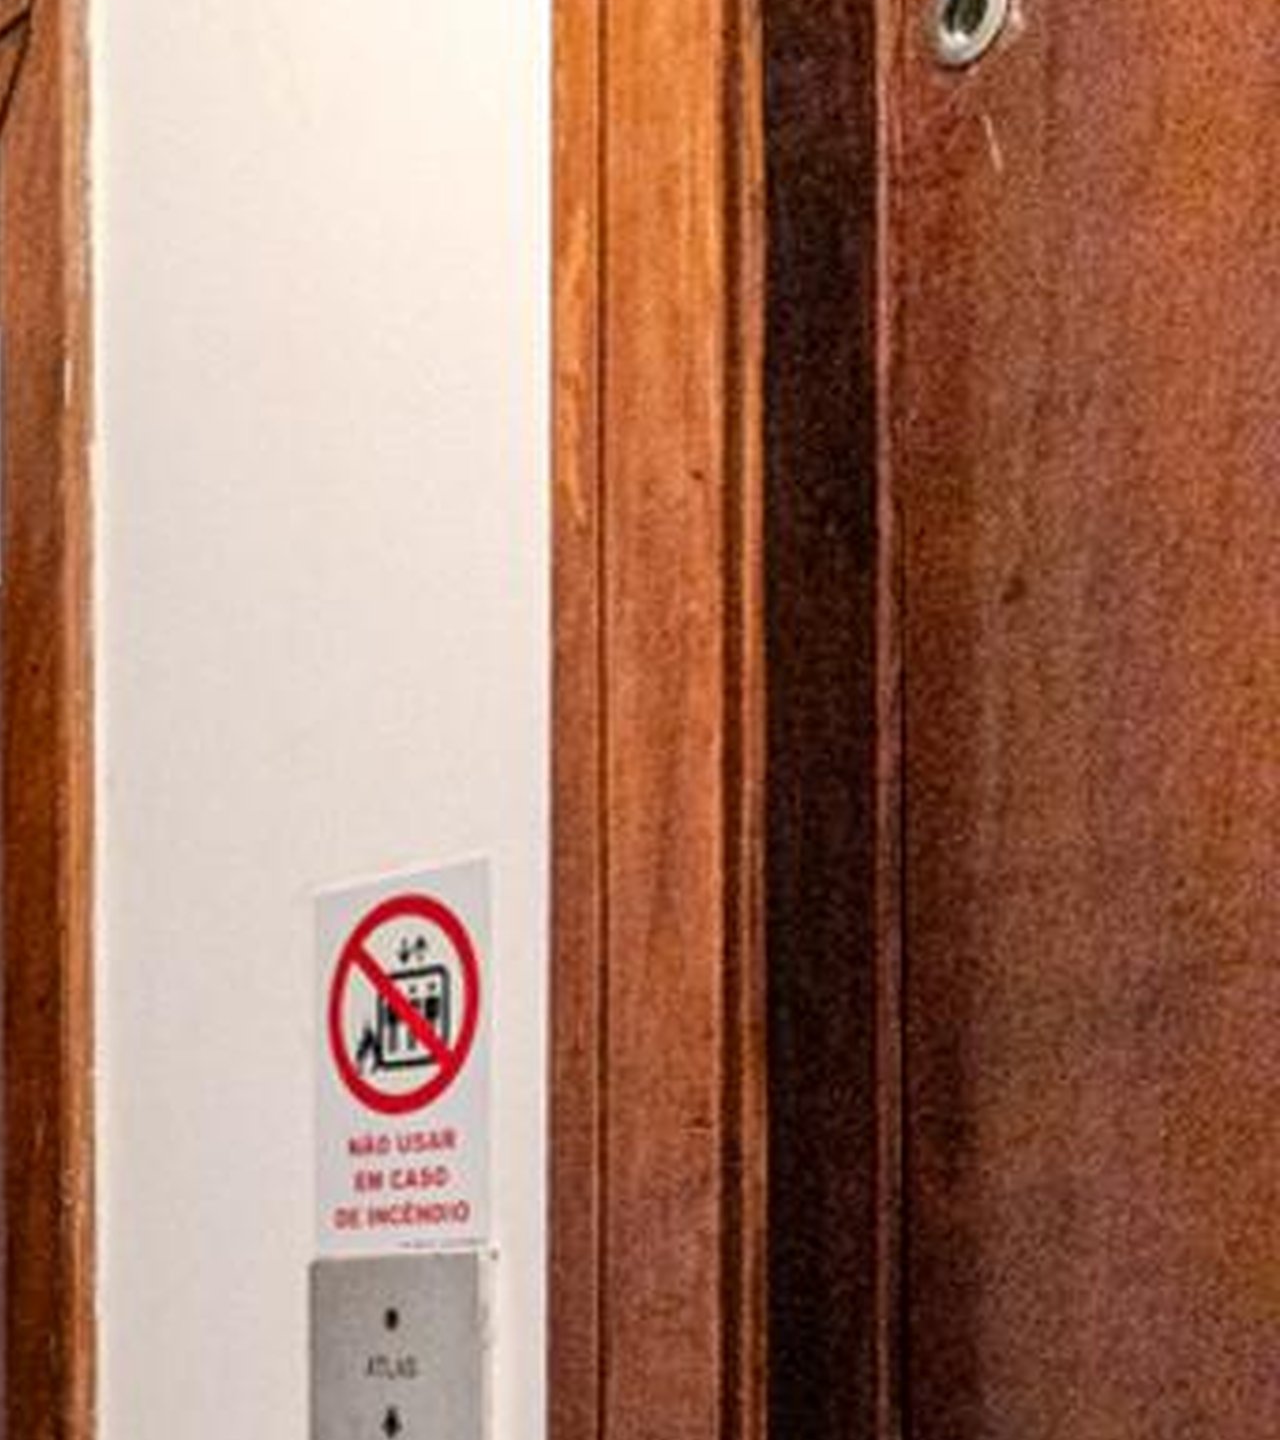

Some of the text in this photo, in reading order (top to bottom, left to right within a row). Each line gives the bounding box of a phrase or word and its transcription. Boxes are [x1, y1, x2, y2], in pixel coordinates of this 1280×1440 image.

[348, 1128, 456, 1155] NÃO USAR
[354, 1165, 449, 1192] EM CASO
[334, 1199, 471, 1230] DE INCÊNDIO
[365, 1355, 417, 1380] ATLAS
